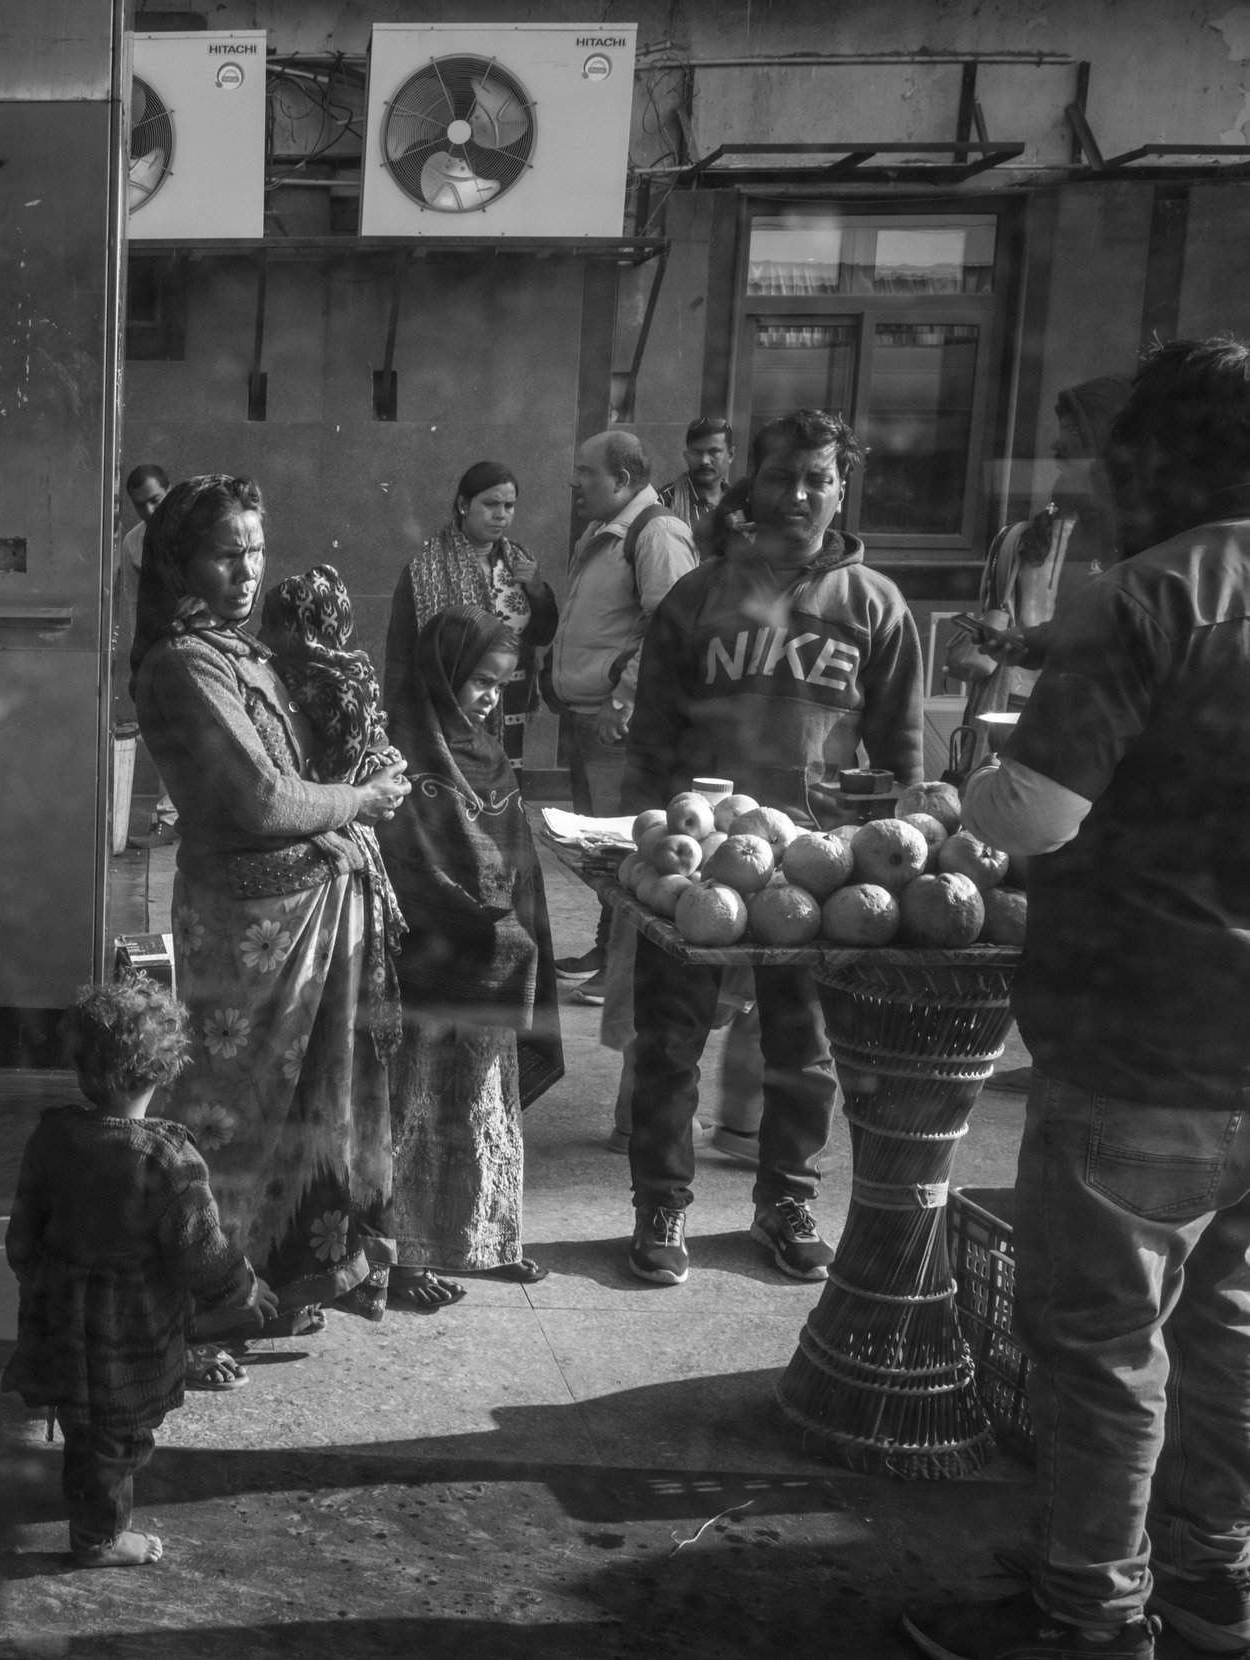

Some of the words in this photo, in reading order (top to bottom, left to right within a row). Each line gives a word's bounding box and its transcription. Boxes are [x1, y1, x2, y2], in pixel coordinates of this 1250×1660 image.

[576, 37, 626, 47] HITACHI
[209, 44, 257, 54] HITACHI
[705, 626, 861, 691] NIKE
